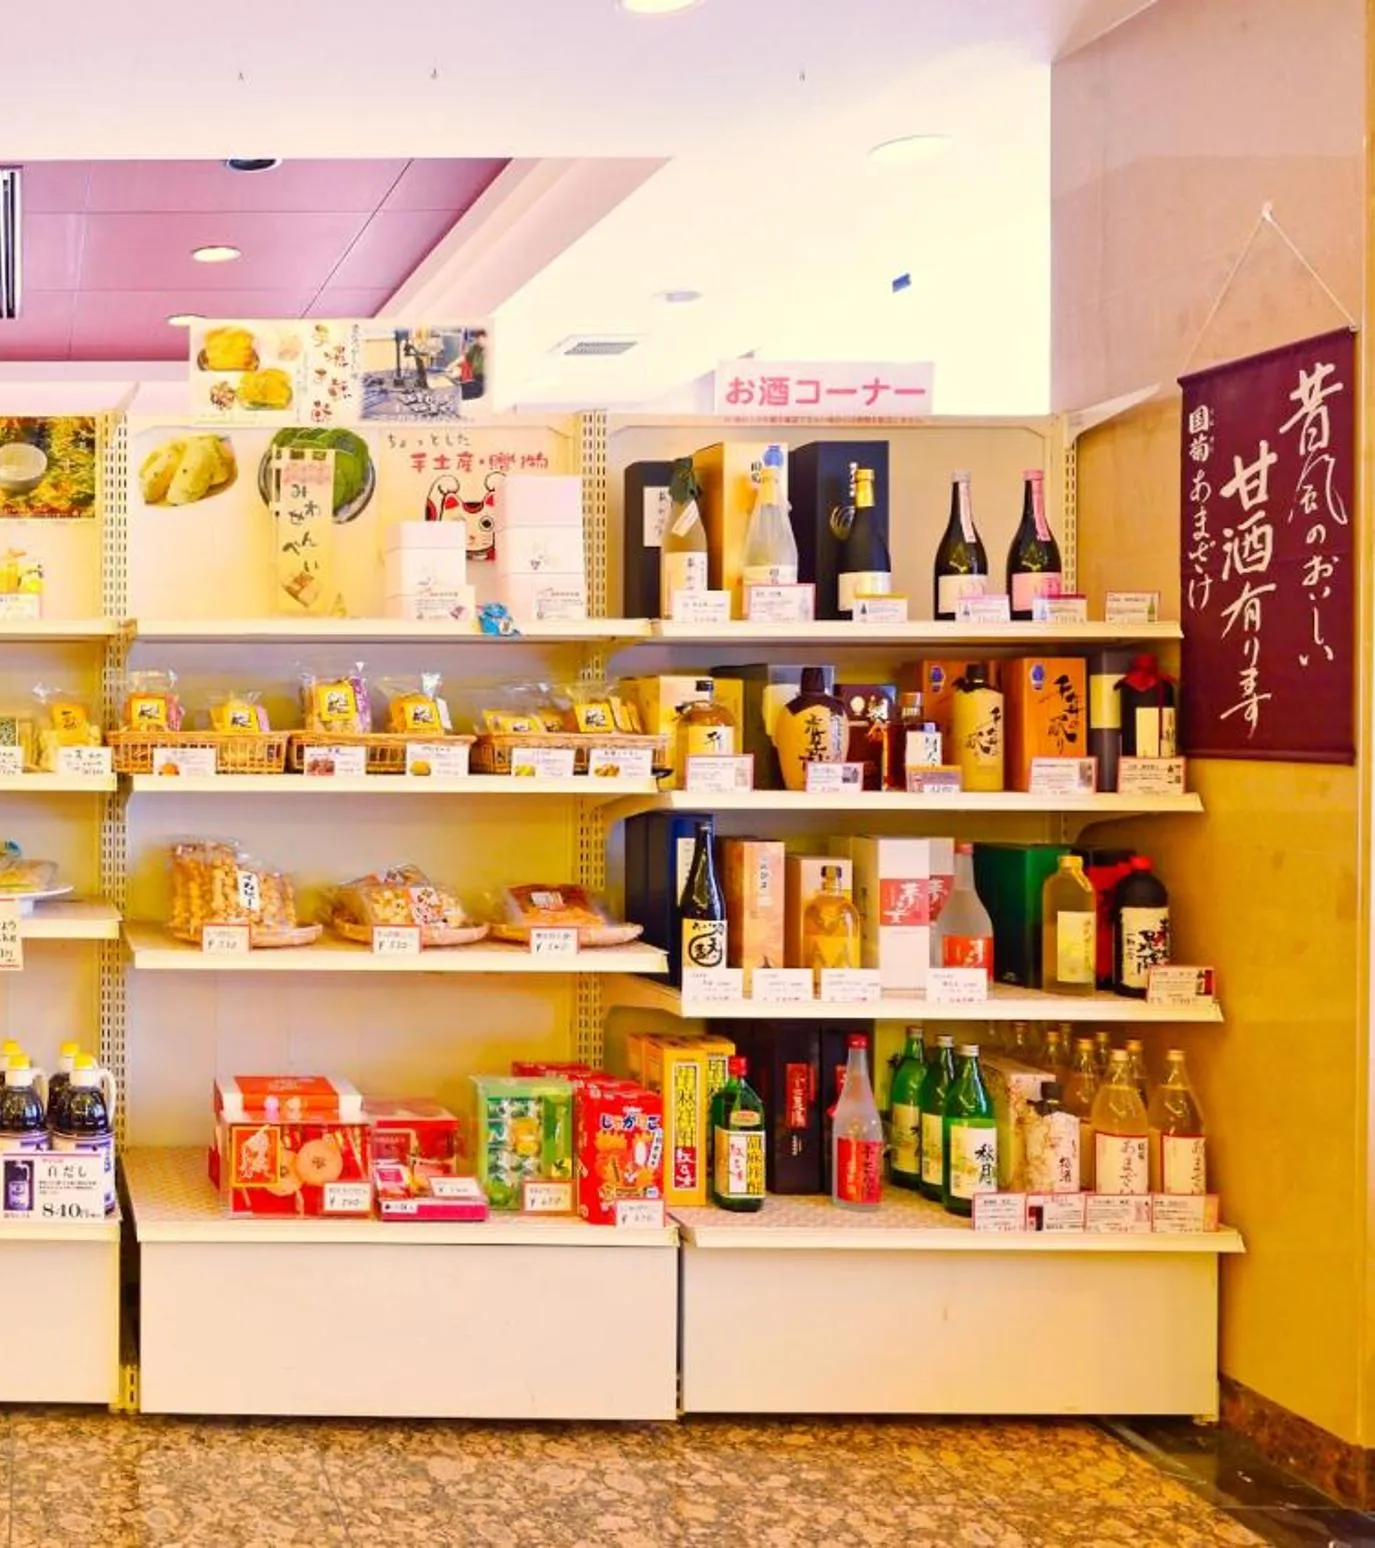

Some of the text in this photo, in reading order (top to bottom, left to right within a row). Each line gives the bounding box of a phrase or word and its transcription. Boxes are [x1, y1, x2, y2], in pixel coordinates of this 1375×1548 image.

[726, 376, 926, 406] お酒コーナー
[1188, 469, 1217, 610] あまざけ
